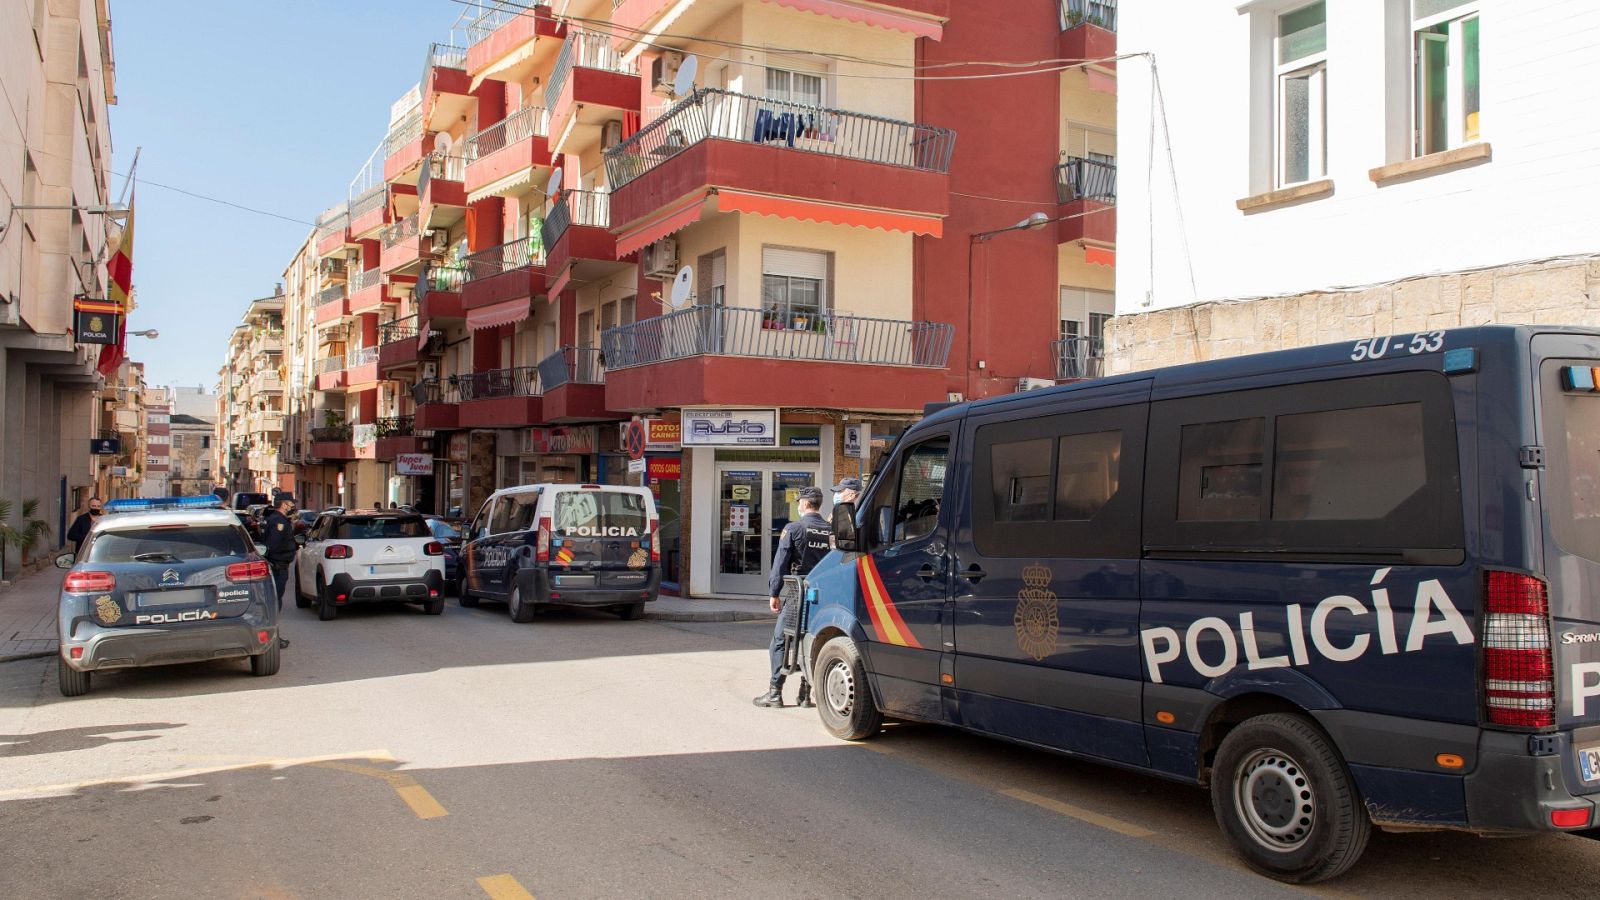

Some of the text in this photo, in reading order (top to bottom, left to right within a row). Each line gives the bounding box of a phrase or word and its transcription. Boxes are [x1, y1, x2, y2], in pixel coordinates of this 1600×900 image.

[651, 424, 681, 432] FOTOS
[565, 526, 638, 537] POLICIA
[136, 609, 211, 624] POLICÍA
[1141, 567, 1475, 684] POLICÍA
